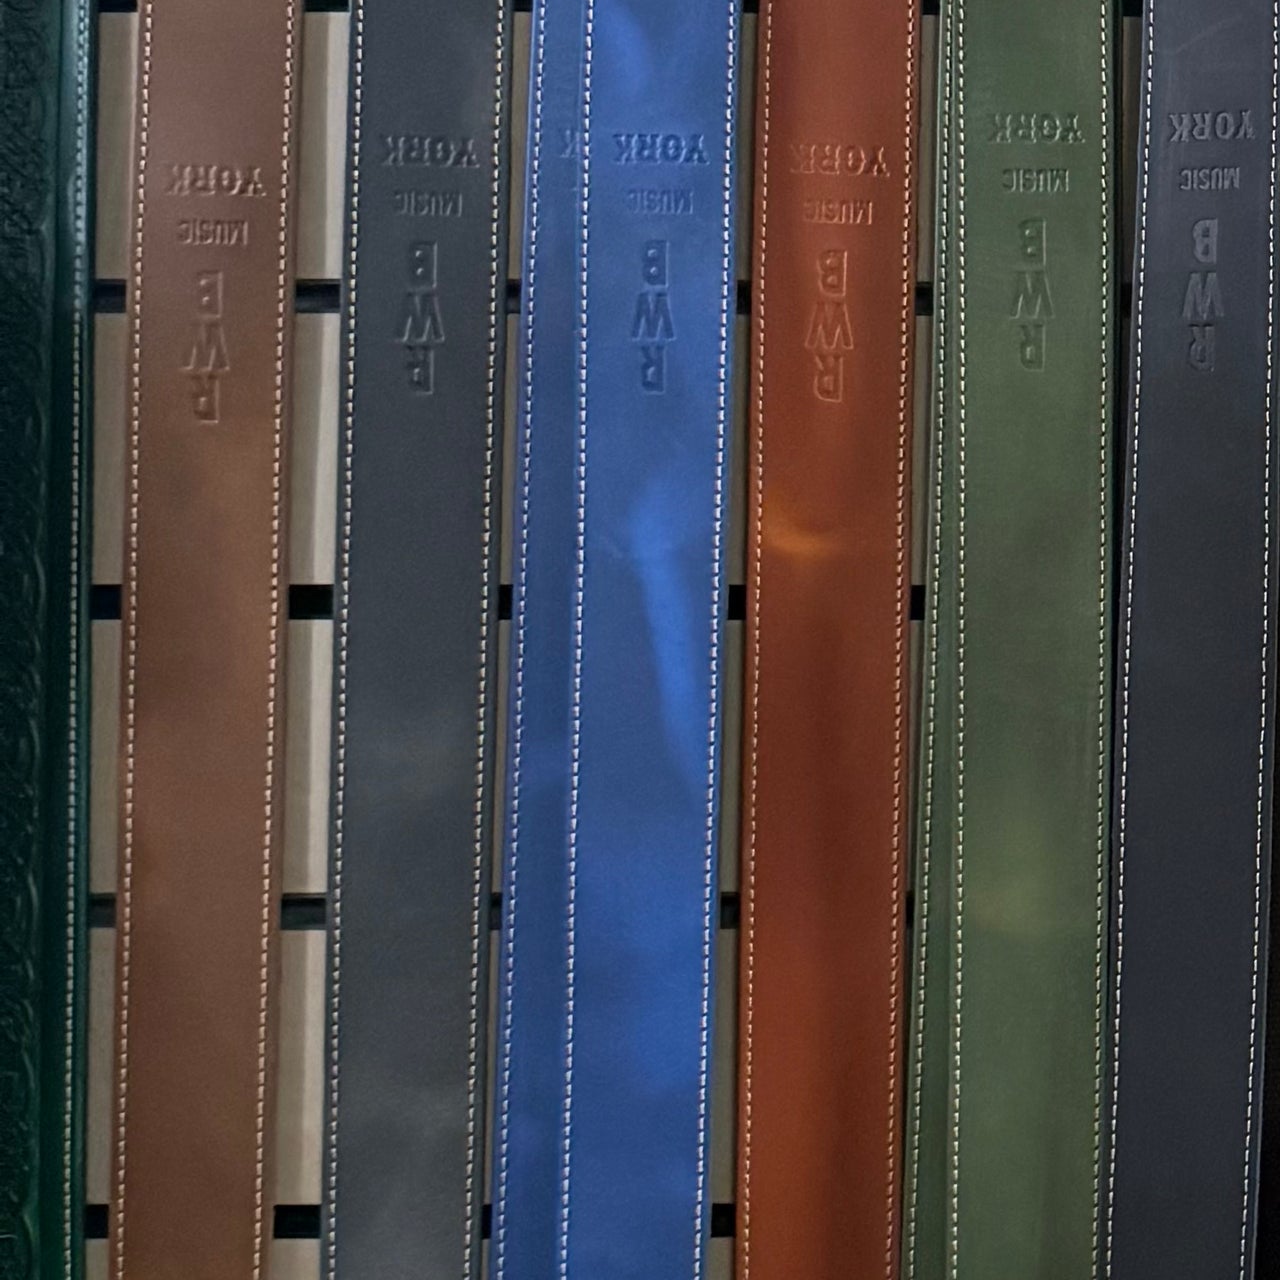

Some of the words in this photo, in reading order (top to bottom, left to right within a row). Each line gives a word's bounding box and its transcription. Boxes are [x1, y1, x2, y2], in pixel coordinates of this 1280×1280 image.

[1167, 110, 1257, 143] YORK
[613, 133, 711, 165] YORK
[1180, 167, 1241, 190] MUSIC
